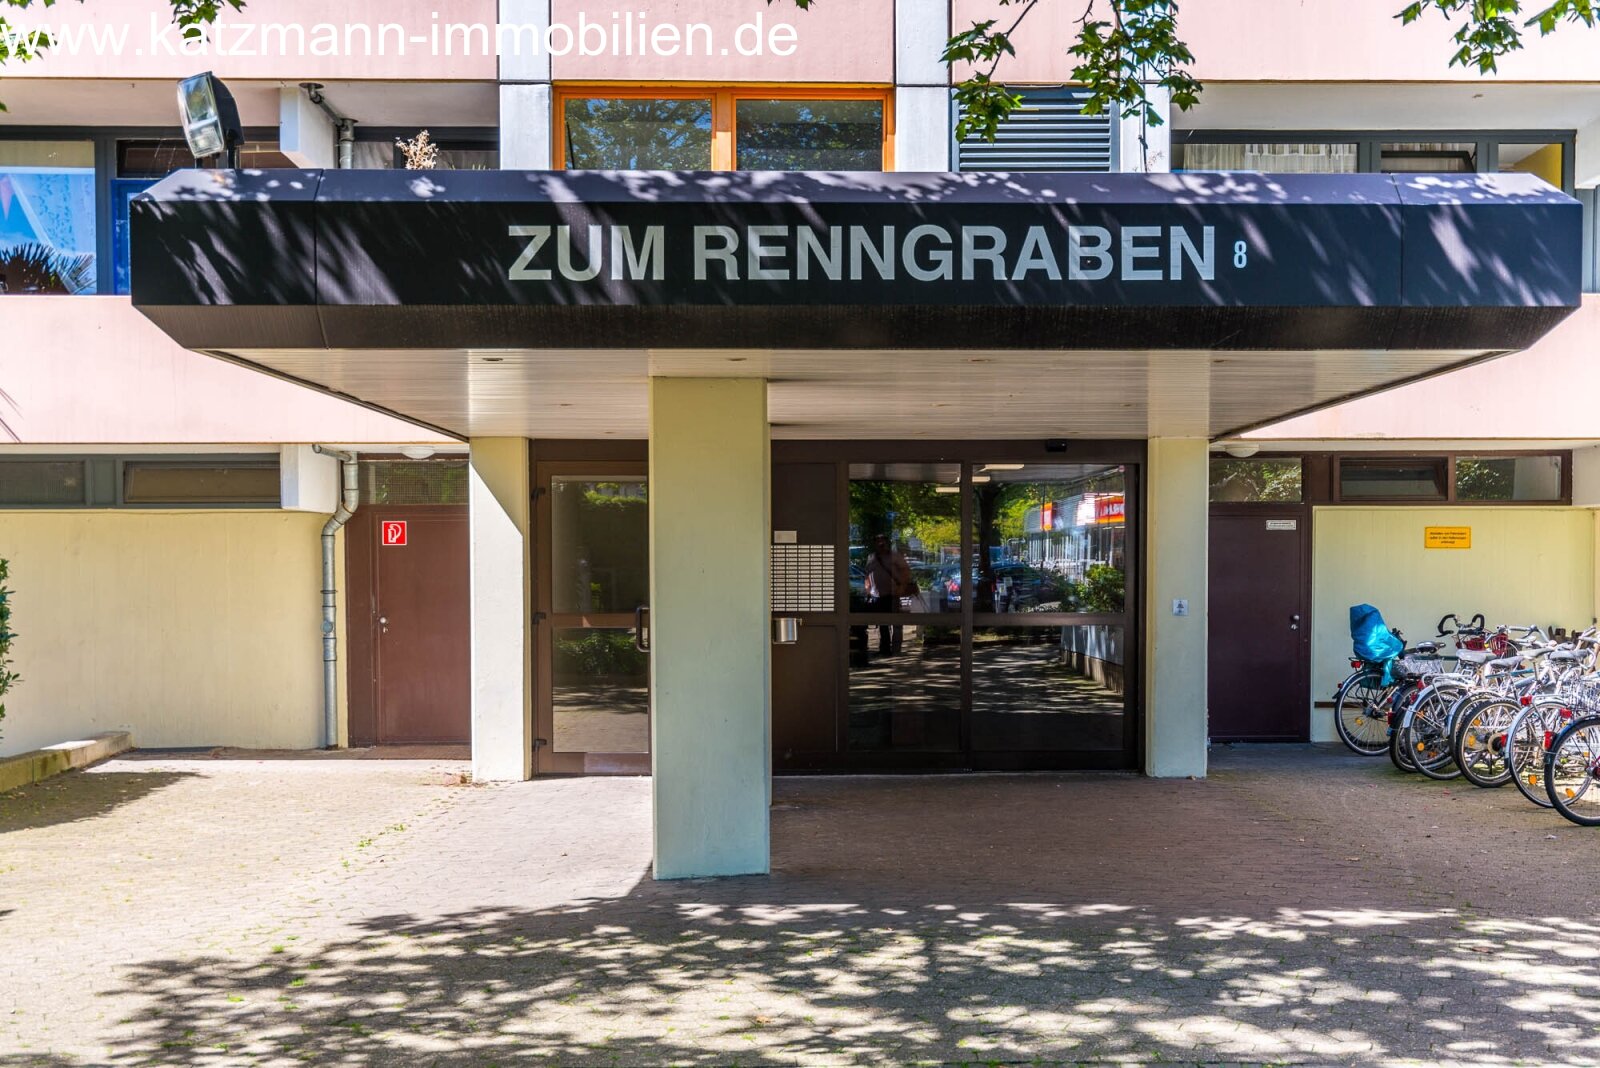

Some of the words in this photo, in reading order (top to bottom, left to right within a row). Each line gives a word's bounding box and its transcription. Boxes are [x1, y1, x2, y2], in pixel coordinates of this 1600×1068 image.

[508, 225, 665, 281] ZUM
[693, 224, 1215, 281] RENNGRABEN
[1233, 240, 1247, 269] 8
